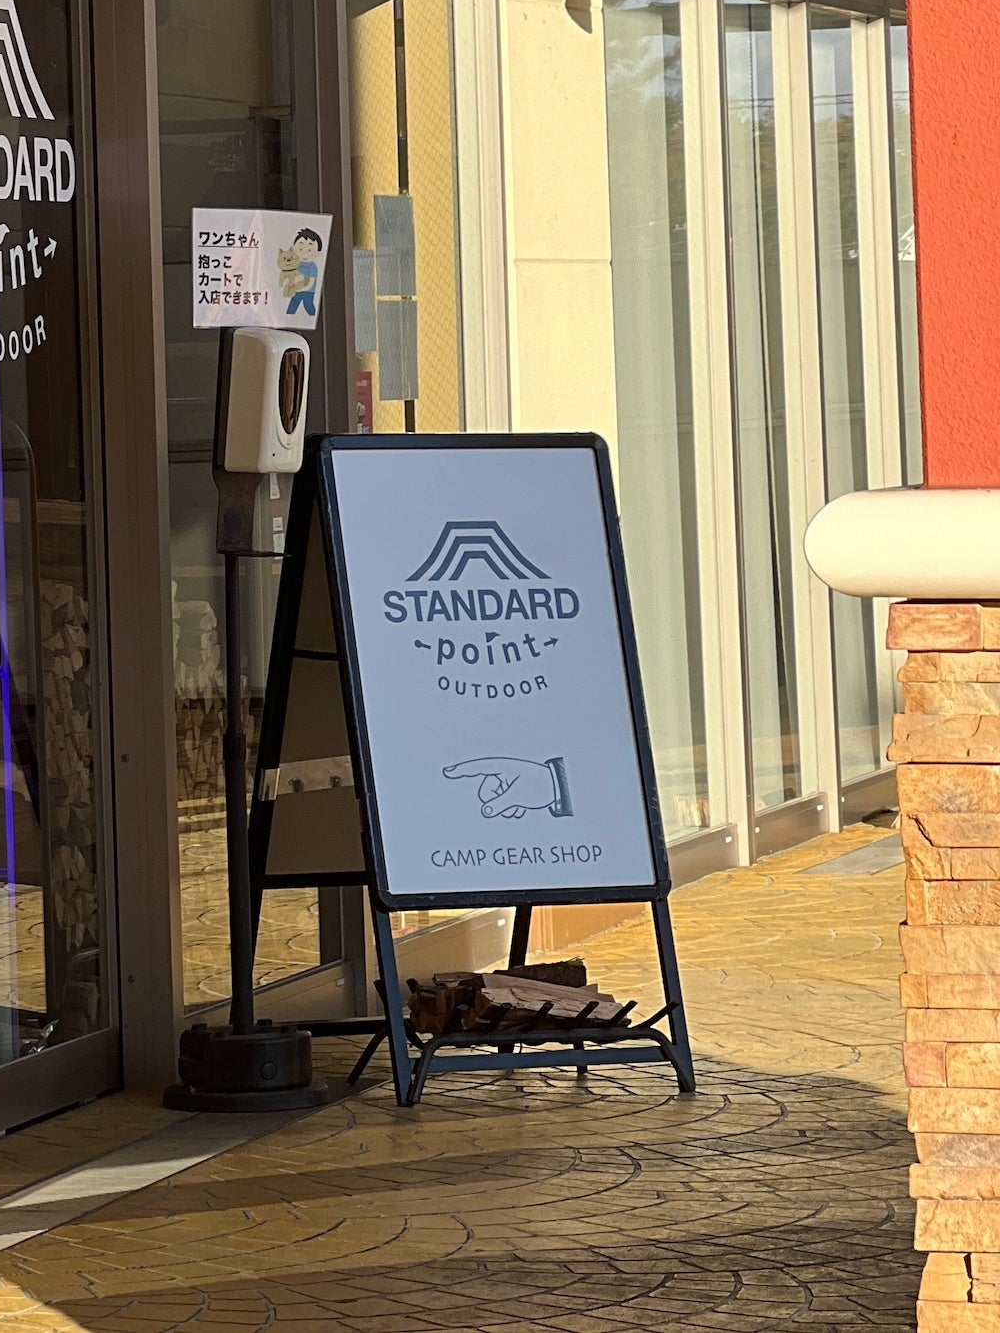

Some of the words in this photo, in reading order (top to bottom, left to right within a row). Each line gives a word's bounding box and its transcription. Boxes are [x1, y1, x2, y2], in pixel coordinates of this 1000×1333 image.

[198, 231, 259, 248] ワンちゃん
[198, 254, 233, 269] 抱っこ
[198, 272, 244, 287] カートで
[383, 588, 581, 623] STANDARD
[436, 631, 541, 665] point
[438, 675, 549, 699] OUTDOOR
[431, 849, 486, 867] CAMP
[493, 847, 546, 865] GEAR
[550, 845, 602, 863] SHOP
